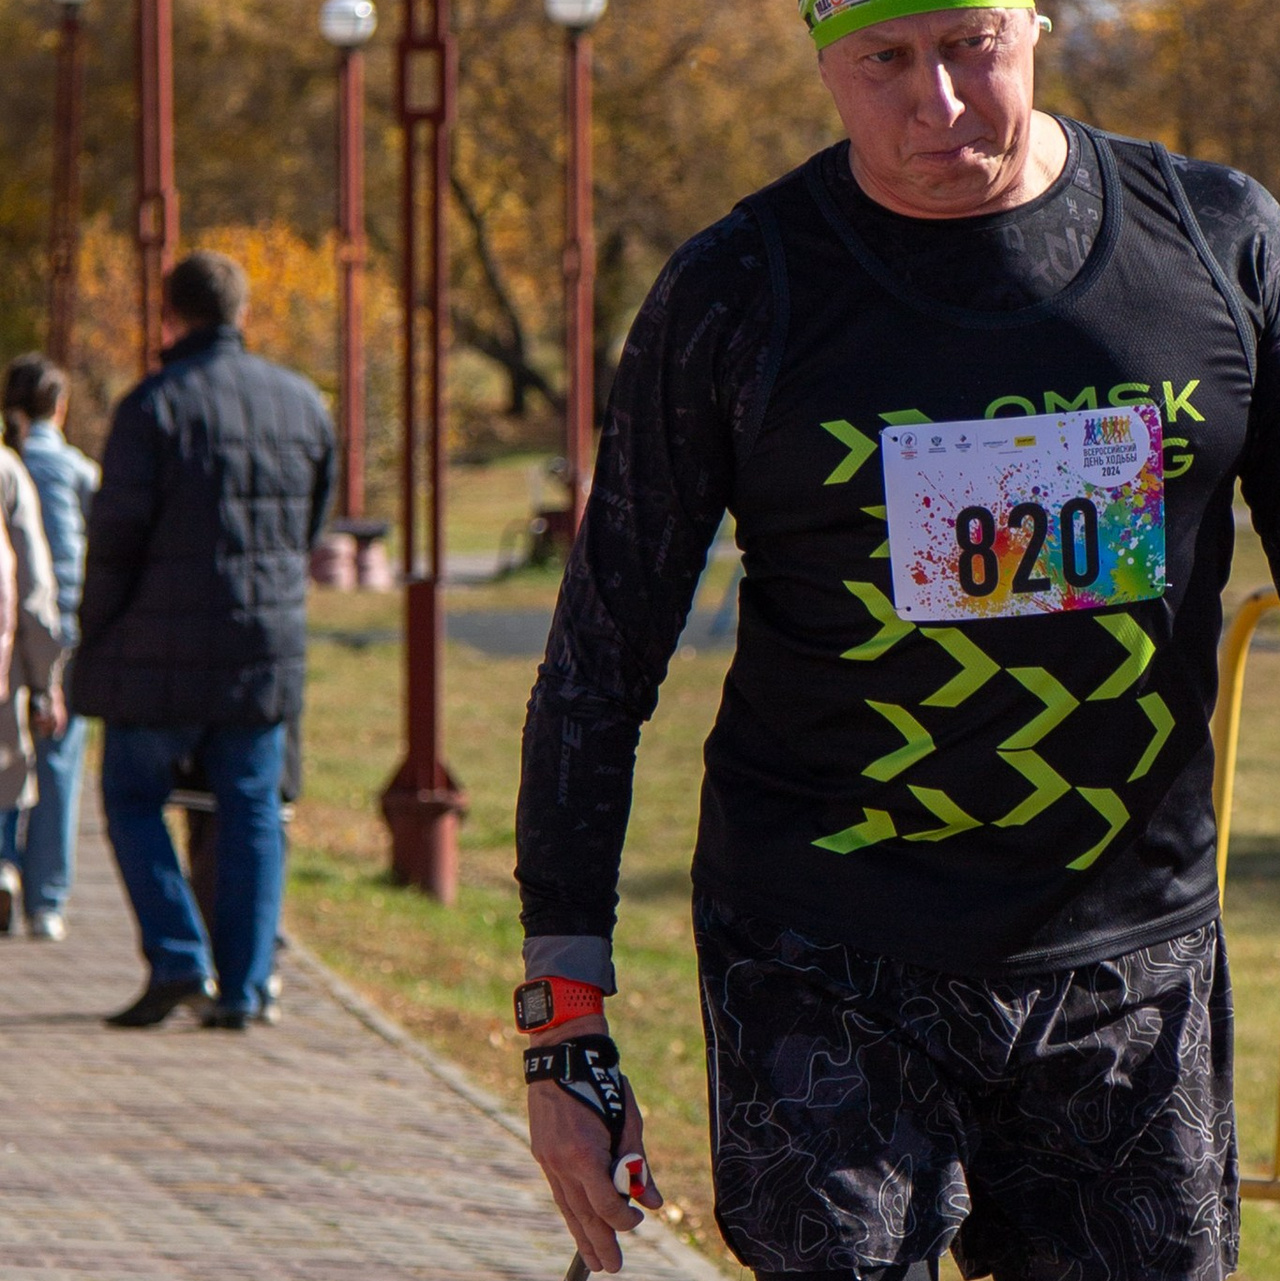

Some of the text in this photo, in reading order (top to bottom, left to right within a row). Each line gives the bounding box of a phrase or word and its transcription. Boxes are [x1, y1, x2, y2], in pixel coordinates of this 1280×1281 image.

[1083, 443, 1137, 457] ВСЕРОССИЙСКИЙ
[1083, 452, 1138, 468] ДЕНЬ ХОДЬБЫ
[1102, 466, 1121, 477] 2024
[956, 497, 1100, 598] 820
[584, 1049, 622, 1111] LEKI
